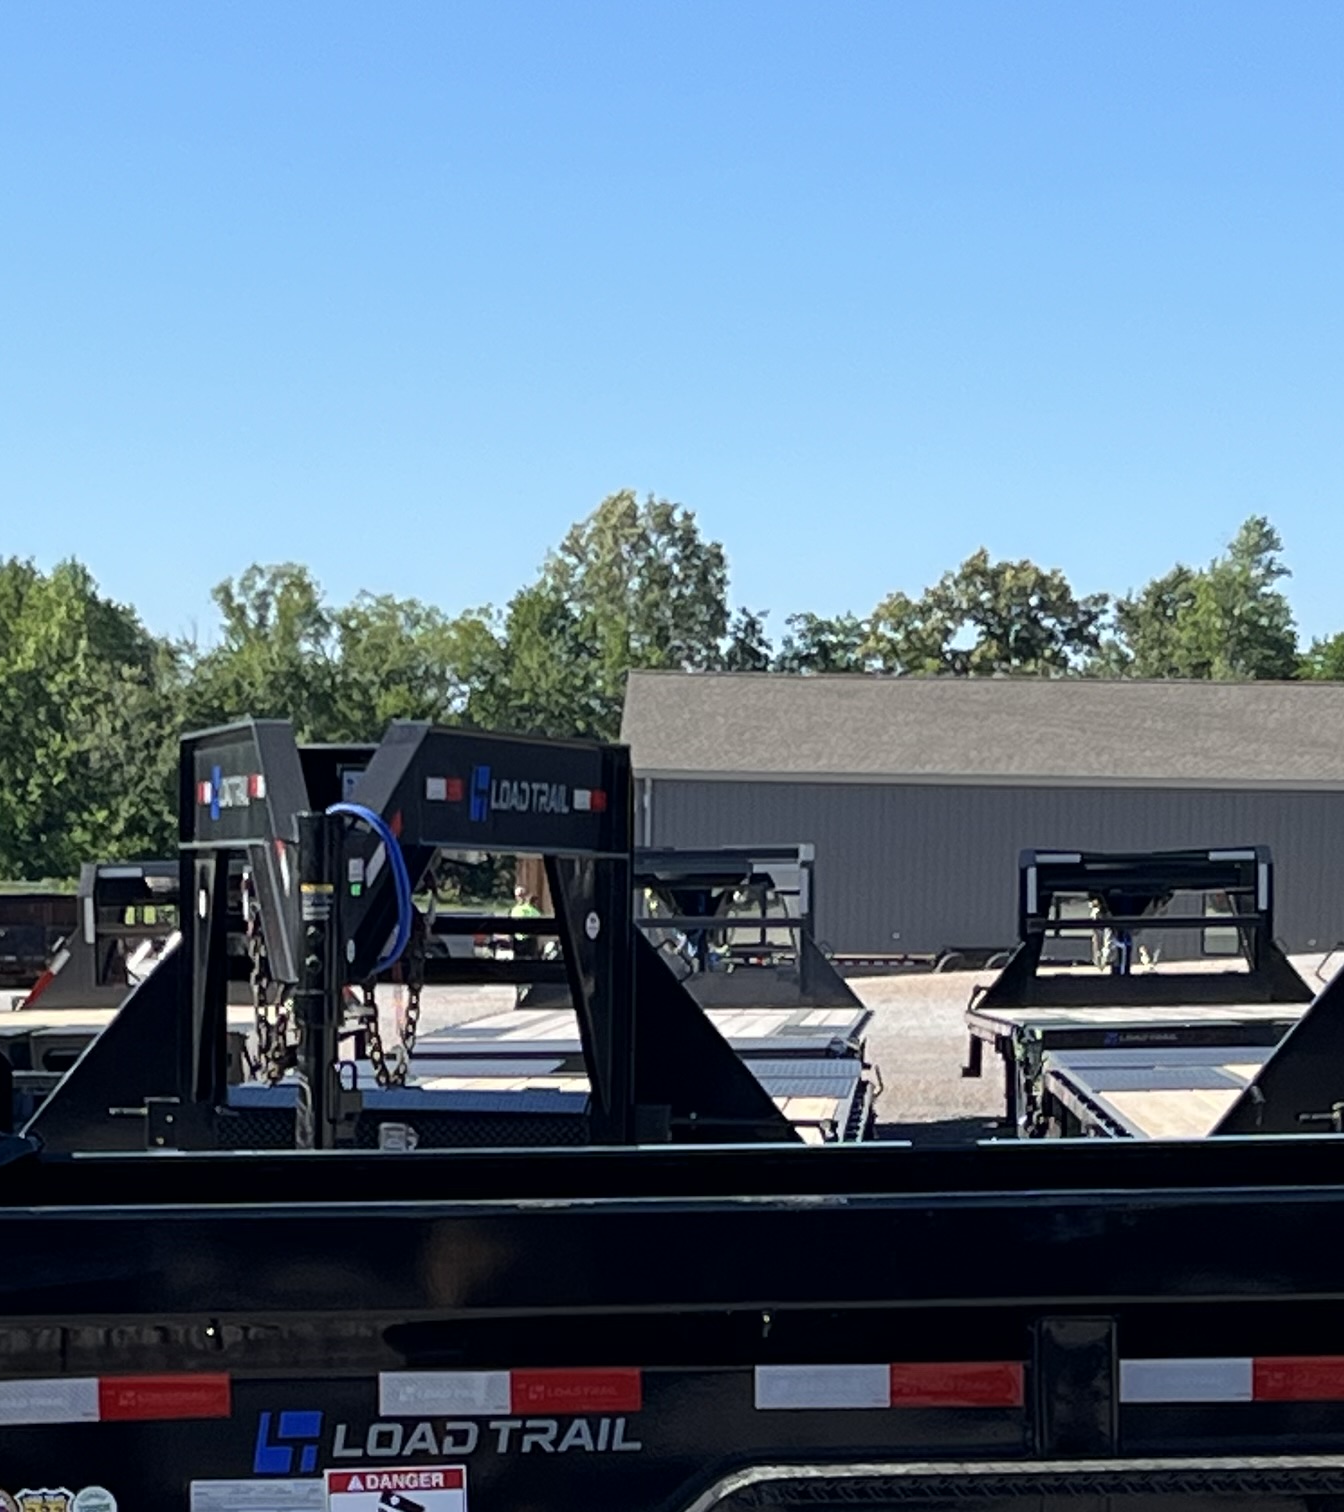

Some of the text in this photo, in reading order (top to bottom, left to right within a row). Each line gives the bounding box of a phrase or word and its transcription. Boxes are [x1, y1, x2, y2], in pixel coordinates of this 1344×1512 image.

[491, 779, 570, 814] LOAD TRAIL
[332, 1417, 642, 1457] LOAD TRAIL
[365, 1472, 444, 1490] DANGER
